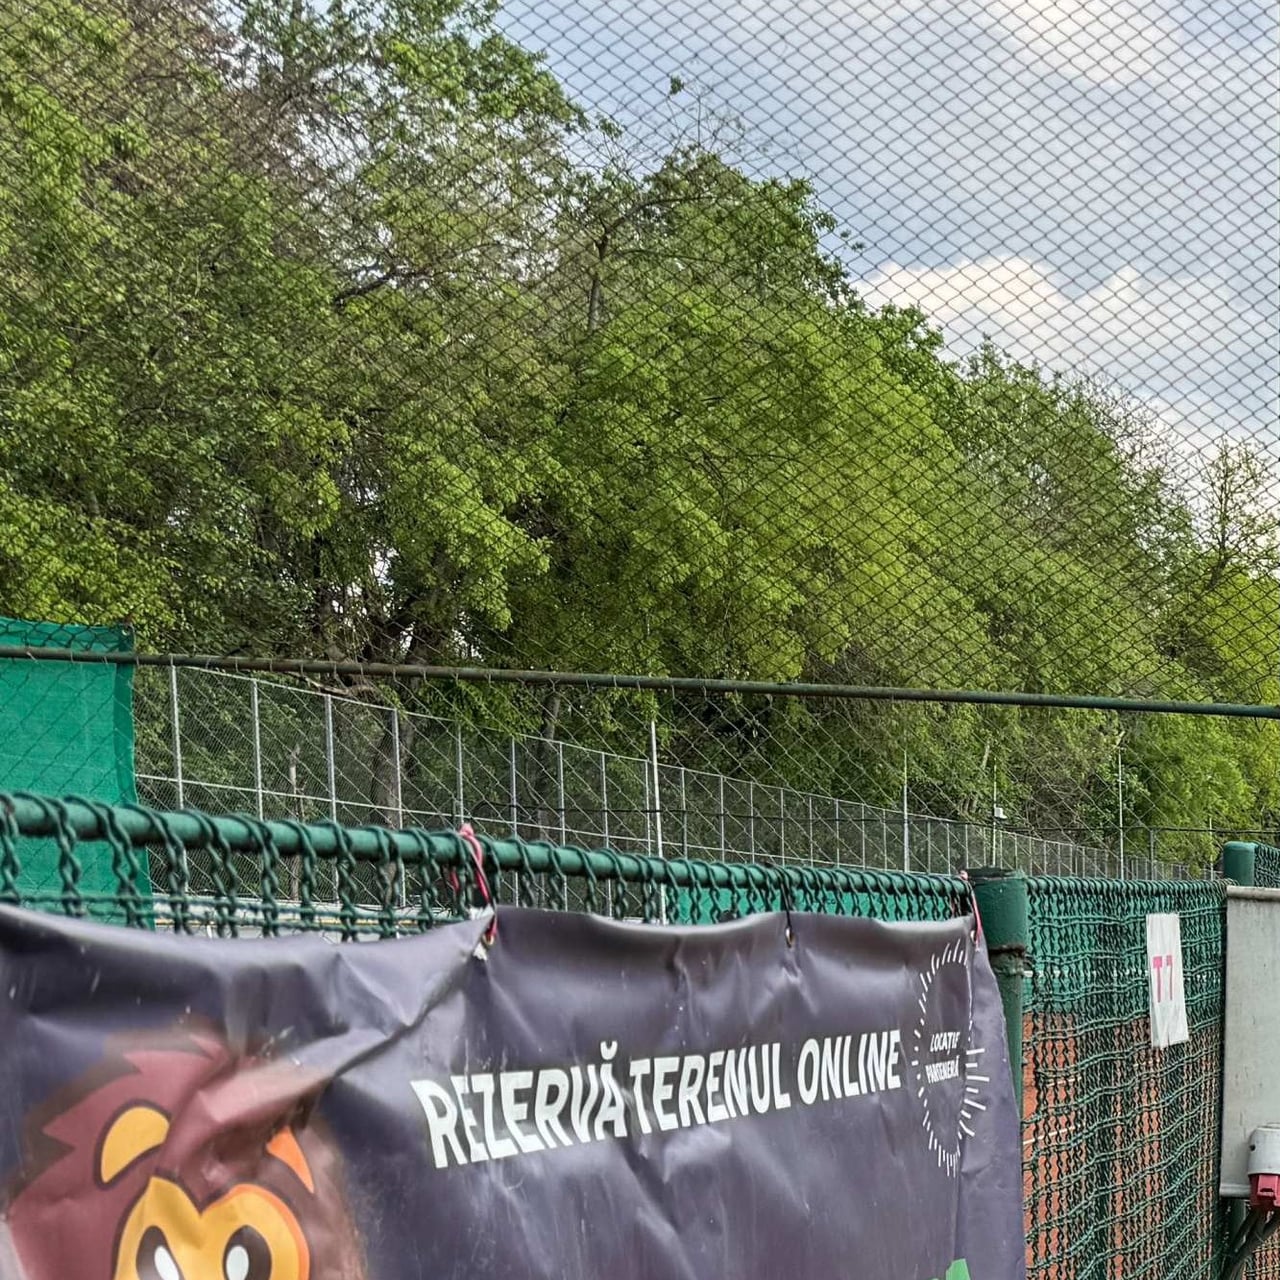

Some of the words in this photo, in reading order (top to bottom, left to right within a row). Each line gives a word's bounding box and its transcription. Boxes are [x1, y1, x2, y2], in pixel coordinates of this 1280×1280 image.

[410, 1040, 627, 1169] REZERVĂ
[629, 1042, 791, 1135] TERENUL
[797, 1029, 901, 1105] ONLINE
